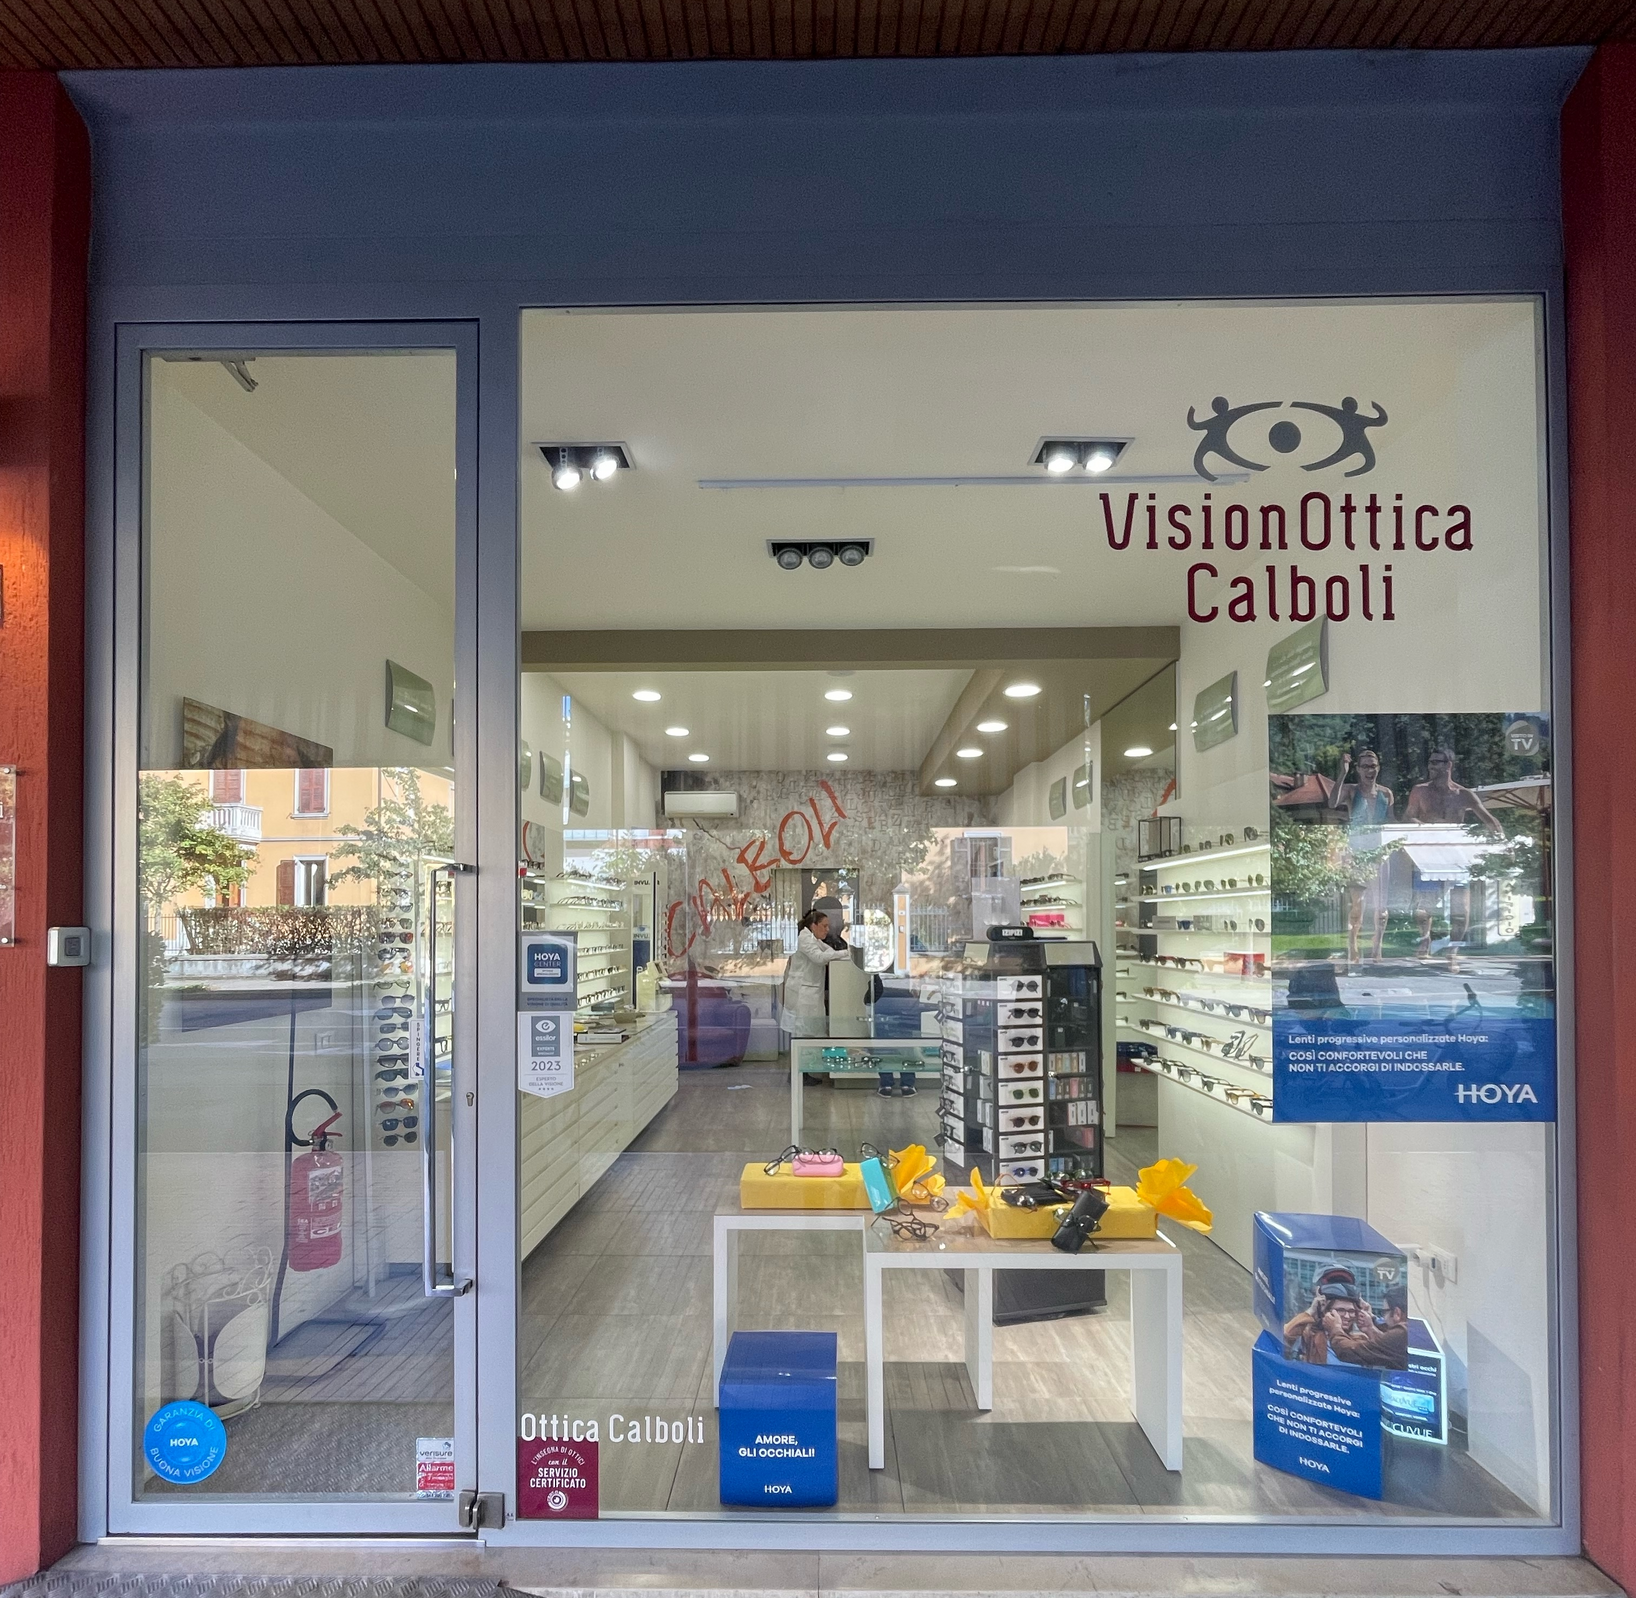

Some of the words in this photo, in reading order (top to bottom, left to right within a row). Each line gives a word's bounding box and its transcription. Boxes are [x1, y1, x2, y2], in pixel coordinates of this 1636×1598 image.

[1099, 491, 1474, 551] VisionOttica
[1187, 562, 1396, 622] Calboli
[1511, 738, 1532, 750] TV
[1289, 1035, 1315, 1044] Lenti
[1317, 1035, 1378, 1045] progressive
[1380, 1034, 1456, 1044] personalizzate
[1458, 1034, 1488, 1044] Hoya:
[1289, 1050, 1315, 1061] COSÌ
[1317, 1051, 1403, 1061] CONFORTEVOLI
[1405, 1051, 1427, 1060] CHE
[531, 1061, 561, 1071] 2023
[1289, 1063, 1314, 1072] NON
[1316, 1063, 1326, 1072] TI
[1328, 1063, 1378, 1072] ACCORGI
[1381, 1063, 1392, 1072] DI
[1394, 1063, 1465, 1072] INDOSSARLE.
[1454, 1084, 1538, 1104] HOYA
[1377, 1271, 1394, 1280] TV
[1276, 1379, 1298, 1391] Lenti
[1300, 1387, 1352, 1406] progressive
[1268, 1387, 1332, 1410] personalizzate
[1334, 1405, 1360, 1418] Hoya:
[153, 1408, 204, 1432] GARANZIA
[204, 1419, 216, 1431] DI
[521, 1413, 600, 1442] Ottica
[609, 1414, 704, 1443] Calboli
[1267, 1404, 1288, 1416] COSÌ
[1290, 1411, 1363, 1438] CONFORTEVOLI
[1267, 1413, 1285, 1424] CHE
[1286, 1419, 1307, 1431] NON
[1309, 1426, 1317, 1434] TI
[1319, 1429, 1363, 1448] ACCORGI
[170, 1438, 198, 1447] HOYA
[755, 1435, 798, 1446] AMORE,
[1279, 1426, 1288, 1435] DI
[1289, 1429, 1350, 1453] INDOSSARLE.
[531, 1446, 559, 1465] L'INSEGNA
[568, 1449, 586, 1465] OTTICI
[738, 1448, 756, 1457] GLI
[758, 1448, 815, 1457] OCCHIALI!
[150, 1447, 181, 1477] BUONA
[184, 1446, 219, 1477] VISIONE
[1299, 1456, 1330, 1473] HOYA
[538, 1468, 578, 1477] SERVIZIO
[530, 1478, 586, 1488] CERTIFICATO
[764, 1485, 792, 1494] HOYA
